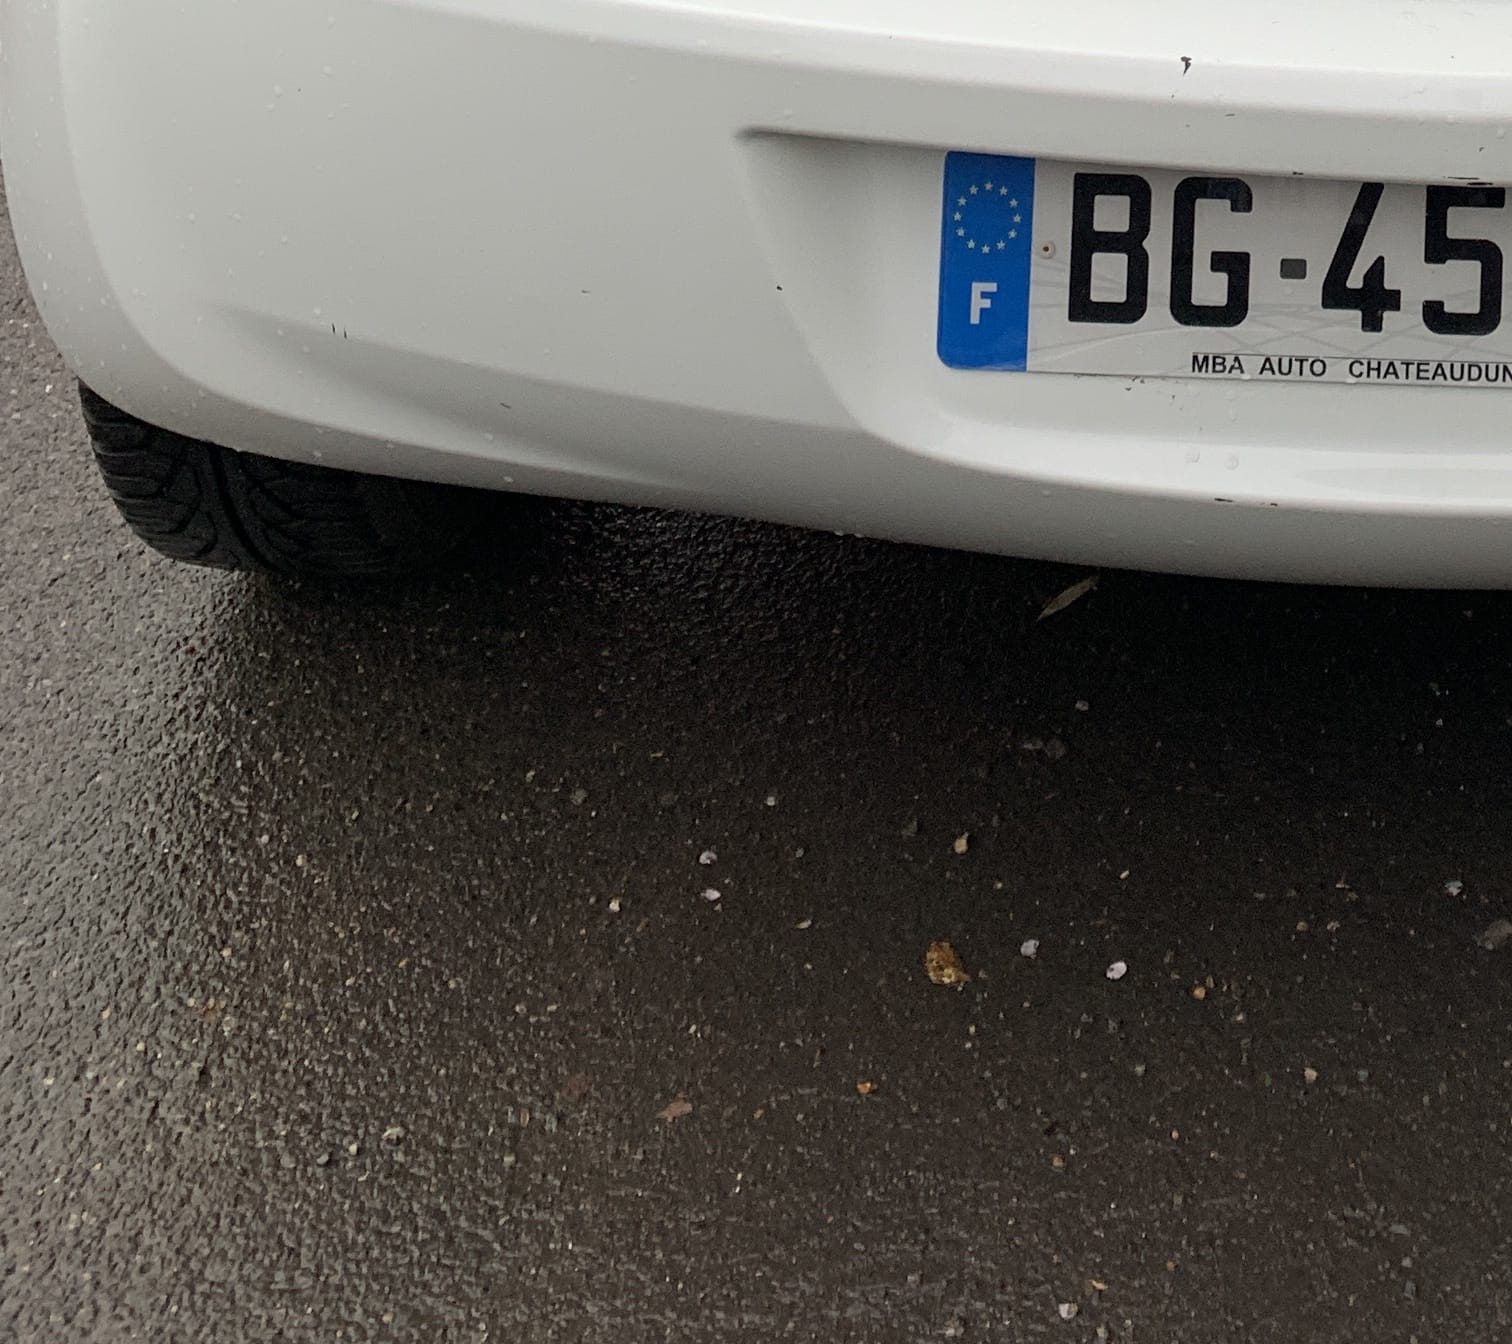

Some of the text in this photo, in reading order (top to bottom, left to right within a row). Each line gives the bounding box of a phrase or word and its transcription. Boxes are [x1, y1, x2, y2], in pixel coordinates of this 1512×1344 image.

[970, 282, 997, 325] F
[1191, 353, 1245, 376] MBA
[1259, 357, 1328, 378] AUTO
